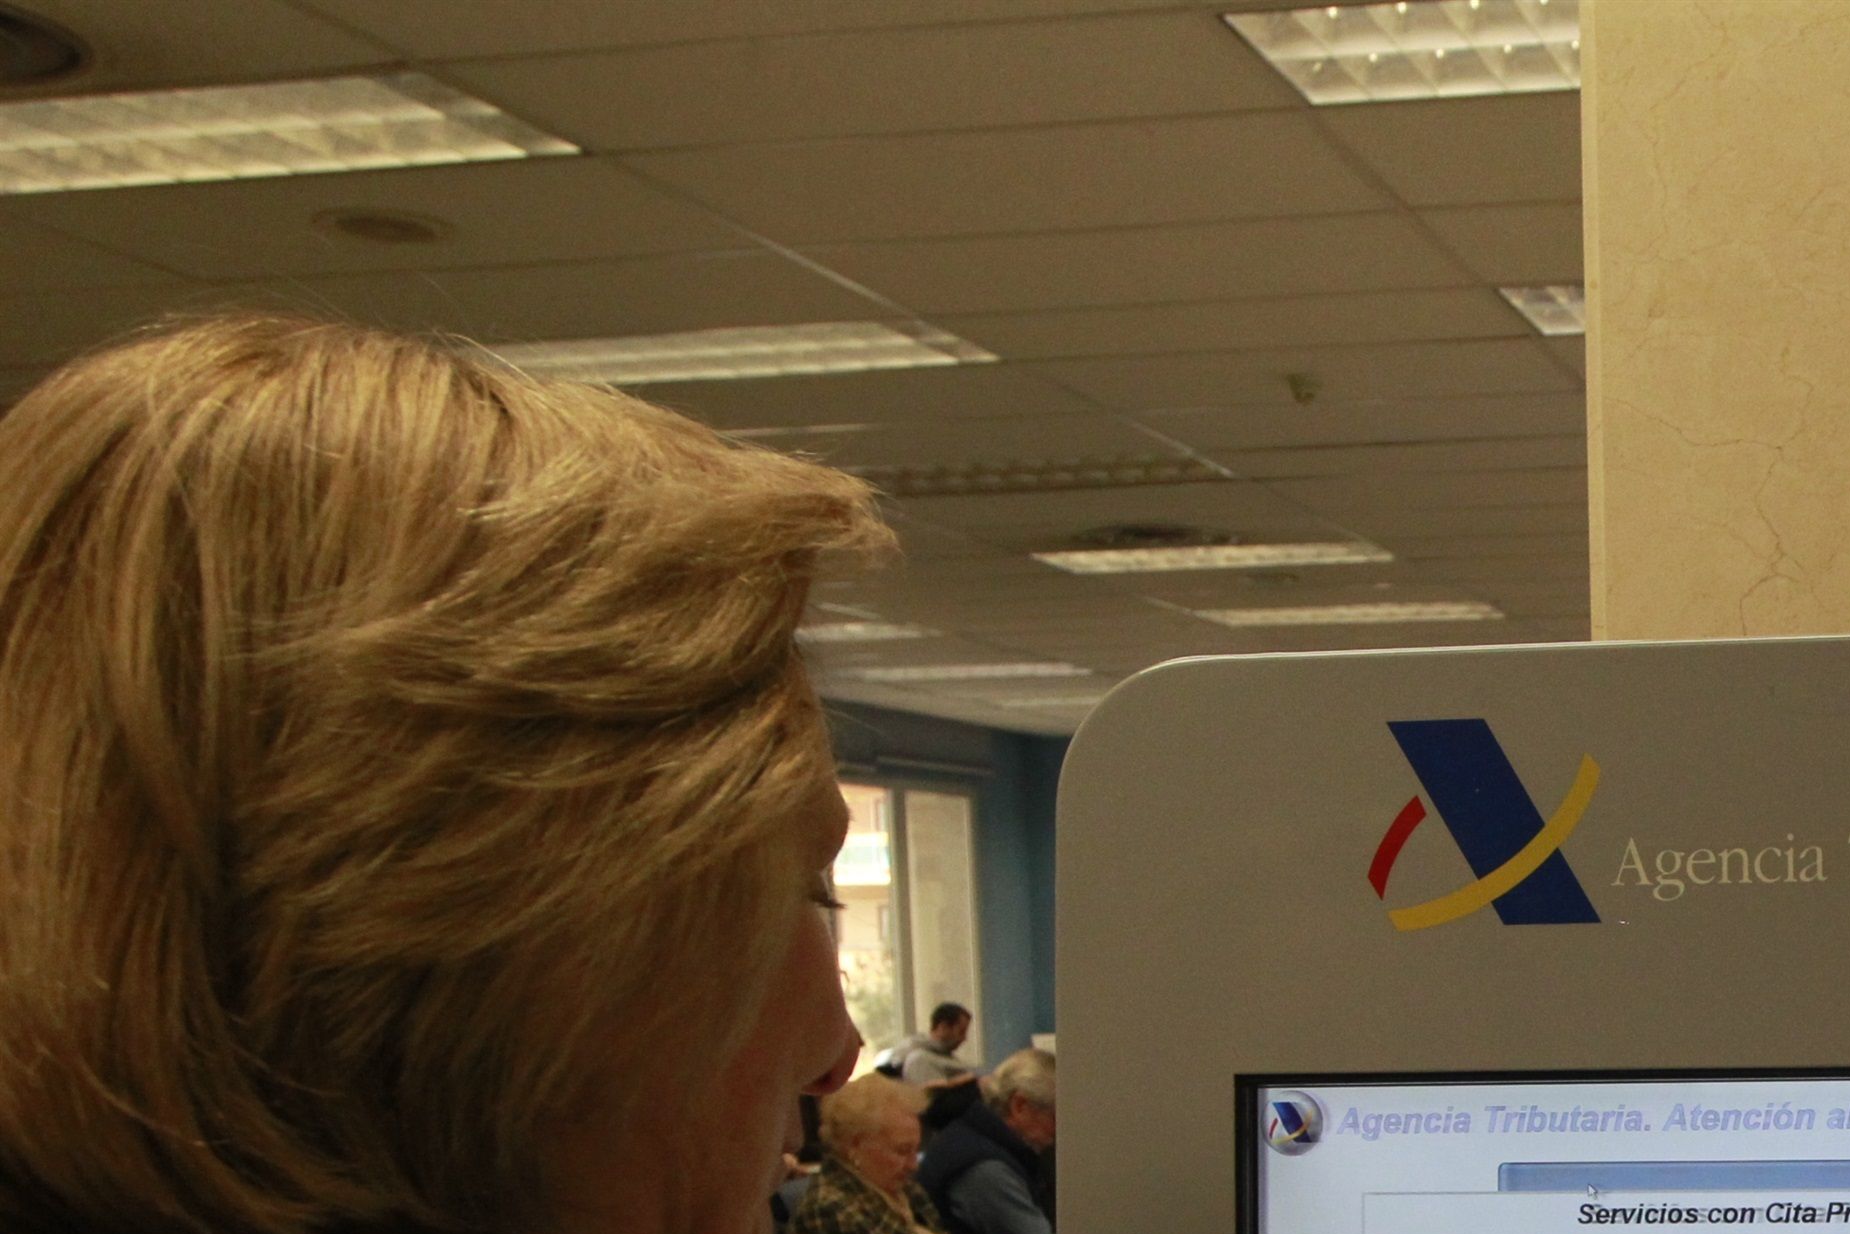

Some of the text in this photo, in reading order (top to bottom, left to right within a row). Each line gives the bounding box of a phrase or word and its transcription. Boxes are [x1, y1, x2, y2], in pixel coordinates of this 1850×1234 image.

[1611, 834, 1827, 901] Agencia
[1337, 1106, 1471, 1140] Agencia
[1484, 1104, 1650, 1133] Tributaria.
[1662, 1102, 1816, 1131] Atención
[1577, 1203, 1699, 1225] Servicios
[1707, 1206, 1755, 1225] con
[1765, 1202, 1817, 1225] Cita
